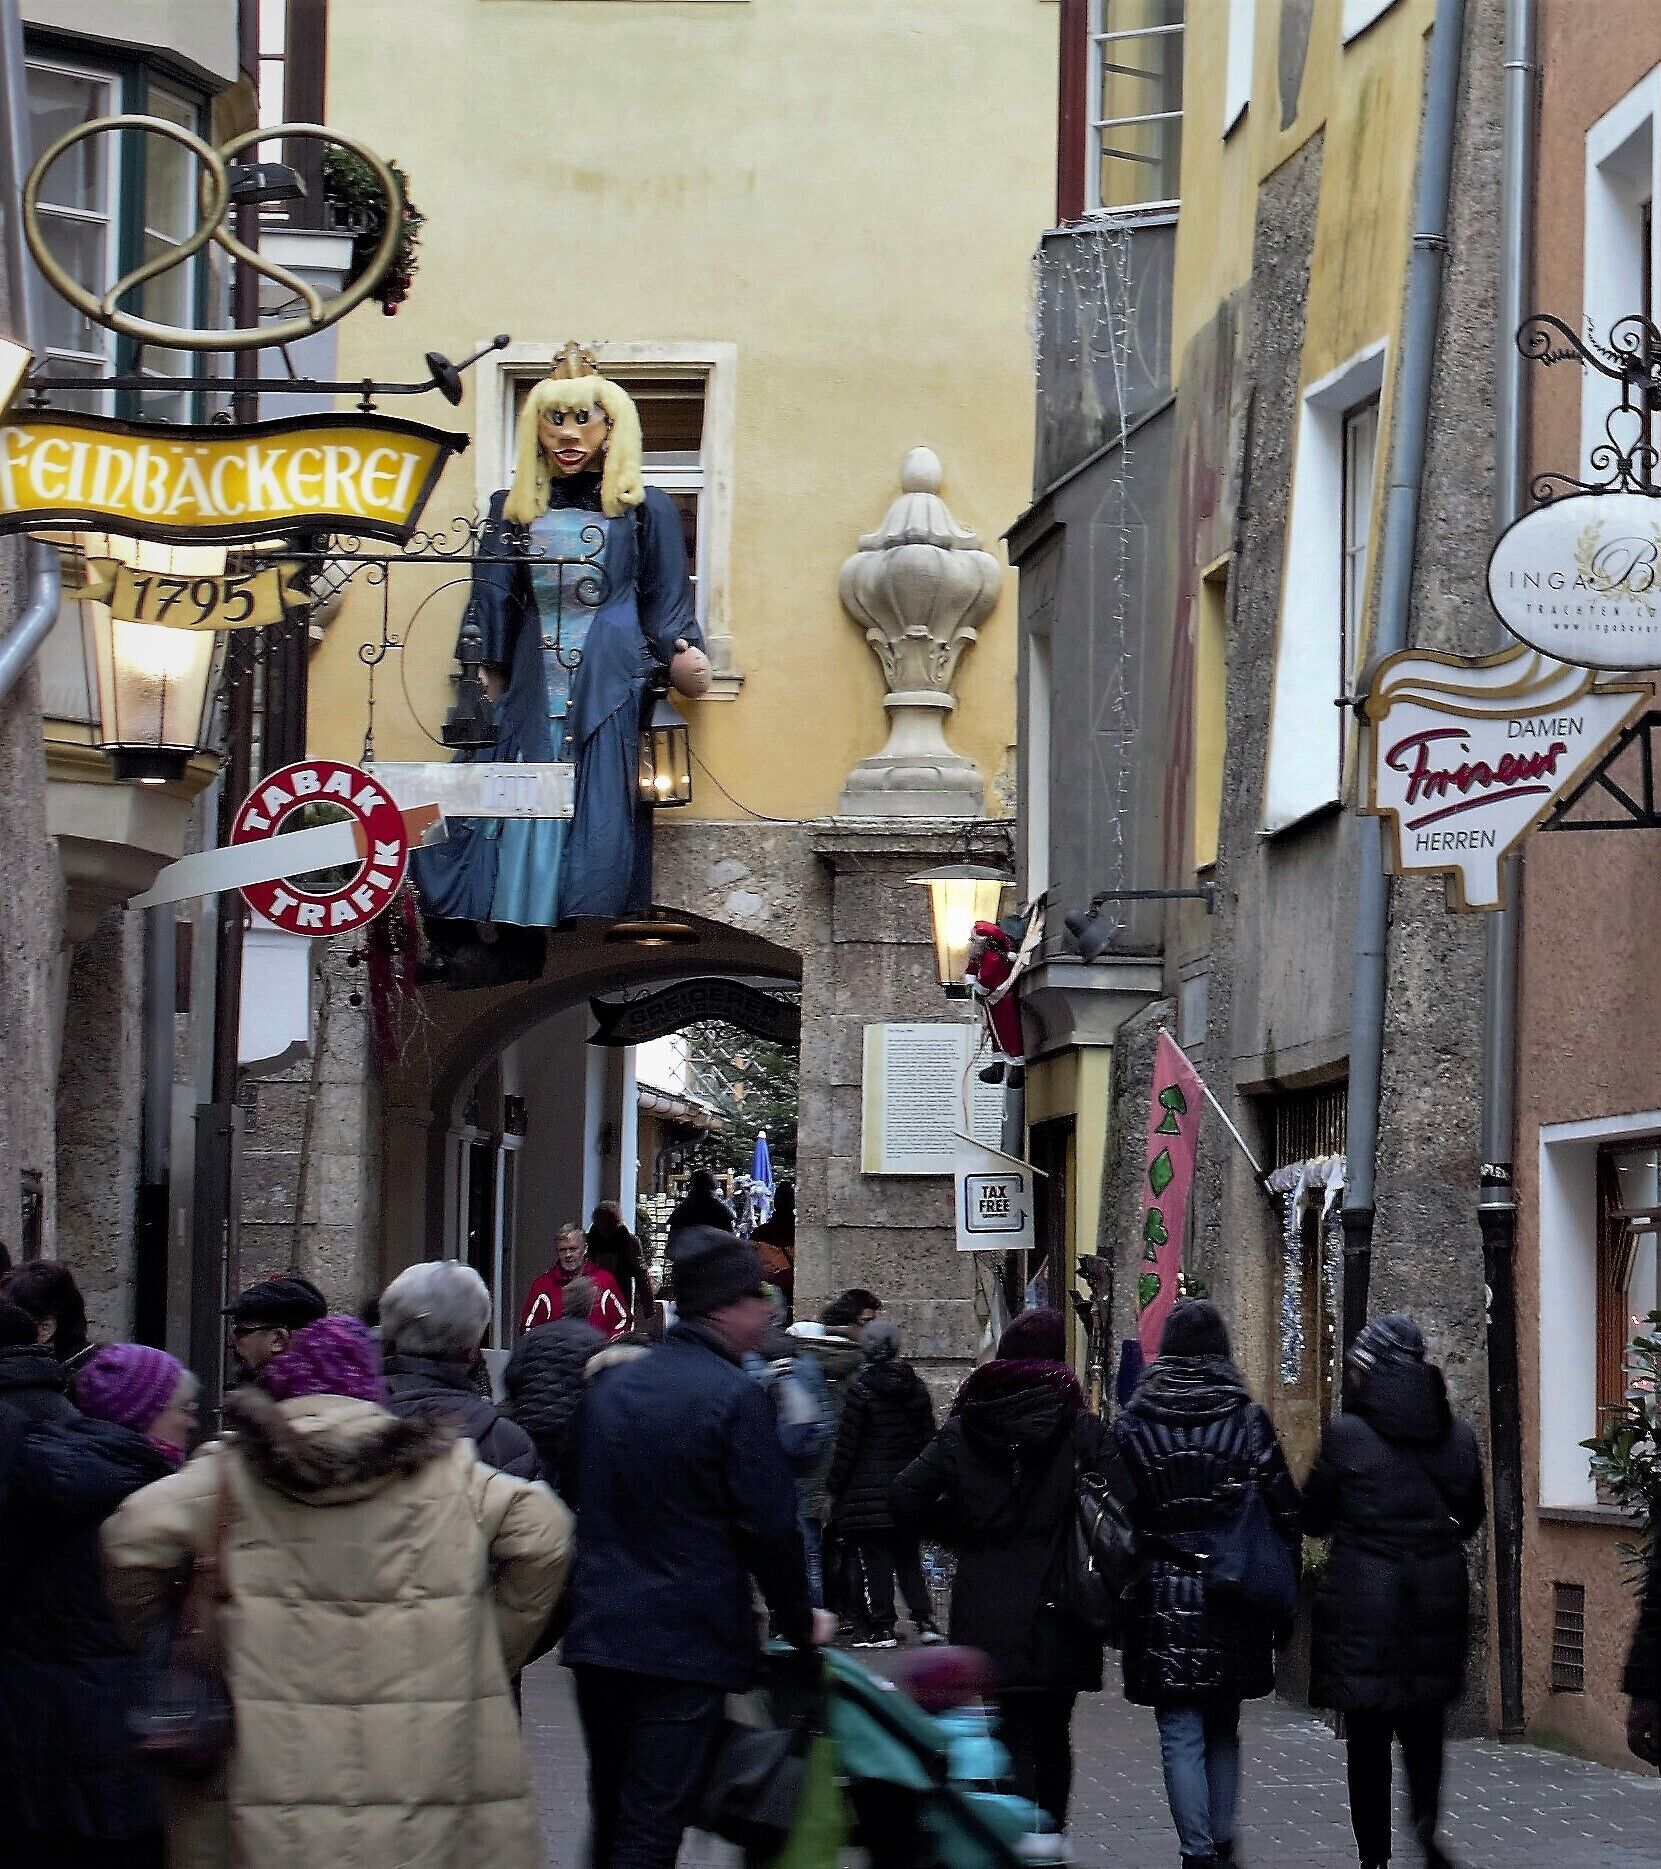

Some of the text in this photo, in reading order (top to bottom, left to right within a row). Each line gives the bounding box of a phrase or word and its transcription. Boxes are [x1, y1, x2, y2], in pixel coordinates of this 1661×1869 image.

[0, 426, 421, 516] FEINBÄCKEREI
[1510, 571, 1587, 590] INGA
[132, 575, 255, 625] 1795
[1507, 717, 1583, 739] DAMEN
[1385, 728, 1567, 806] Friseur
[242, 769, 387, 831] TABAK
[1416, 830, 1496, 852] HERREN
[269, 839, 401, 928] TRAFIK
[979, 1199, 1010, 1213] FREE
[981, 1185, 1008, 1199] TAX
